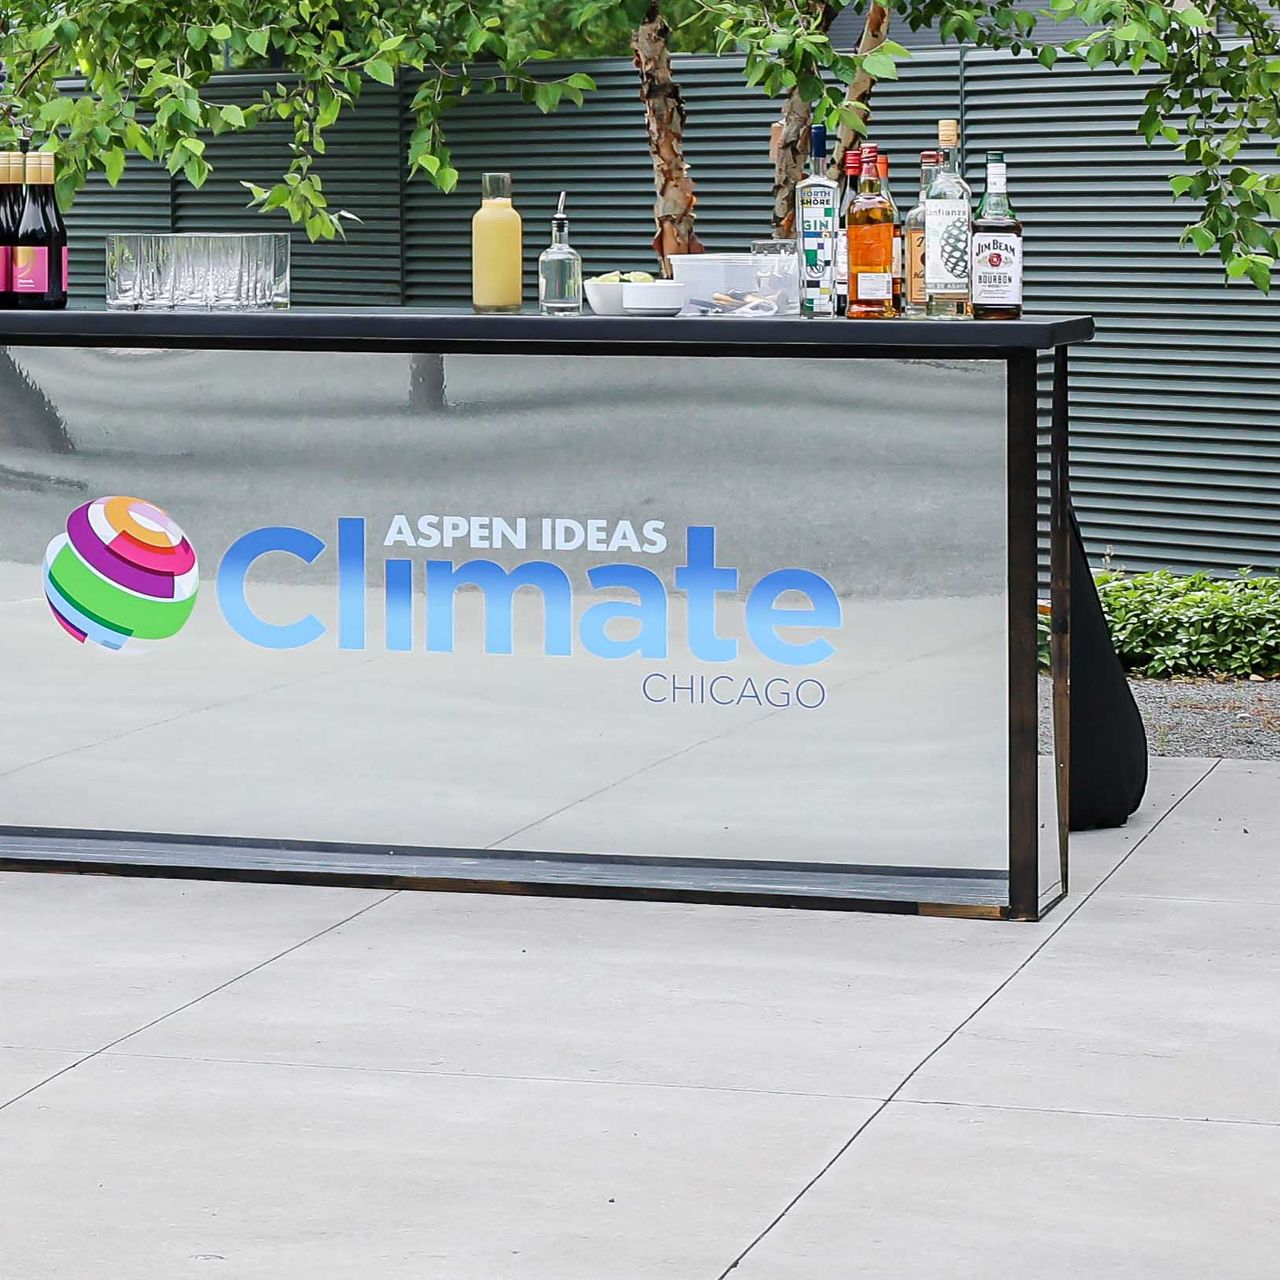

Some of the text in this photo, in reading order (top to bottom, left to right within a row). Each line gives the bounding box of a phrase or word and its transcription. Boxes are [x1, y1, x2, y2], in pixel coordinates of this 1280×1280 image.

[800, 198, 831, 206] SHORE
[803, 219, 829, 231] GIN
[975, 239, 1016, 257] JIM BEAM
[977, 275, 1013, 284] BOURBON
[383, 513, 668, 554] ASPEN IDEAS
[215, 516, 844, 667] Climate
[642, 672, 828, 710] CHICAGO
